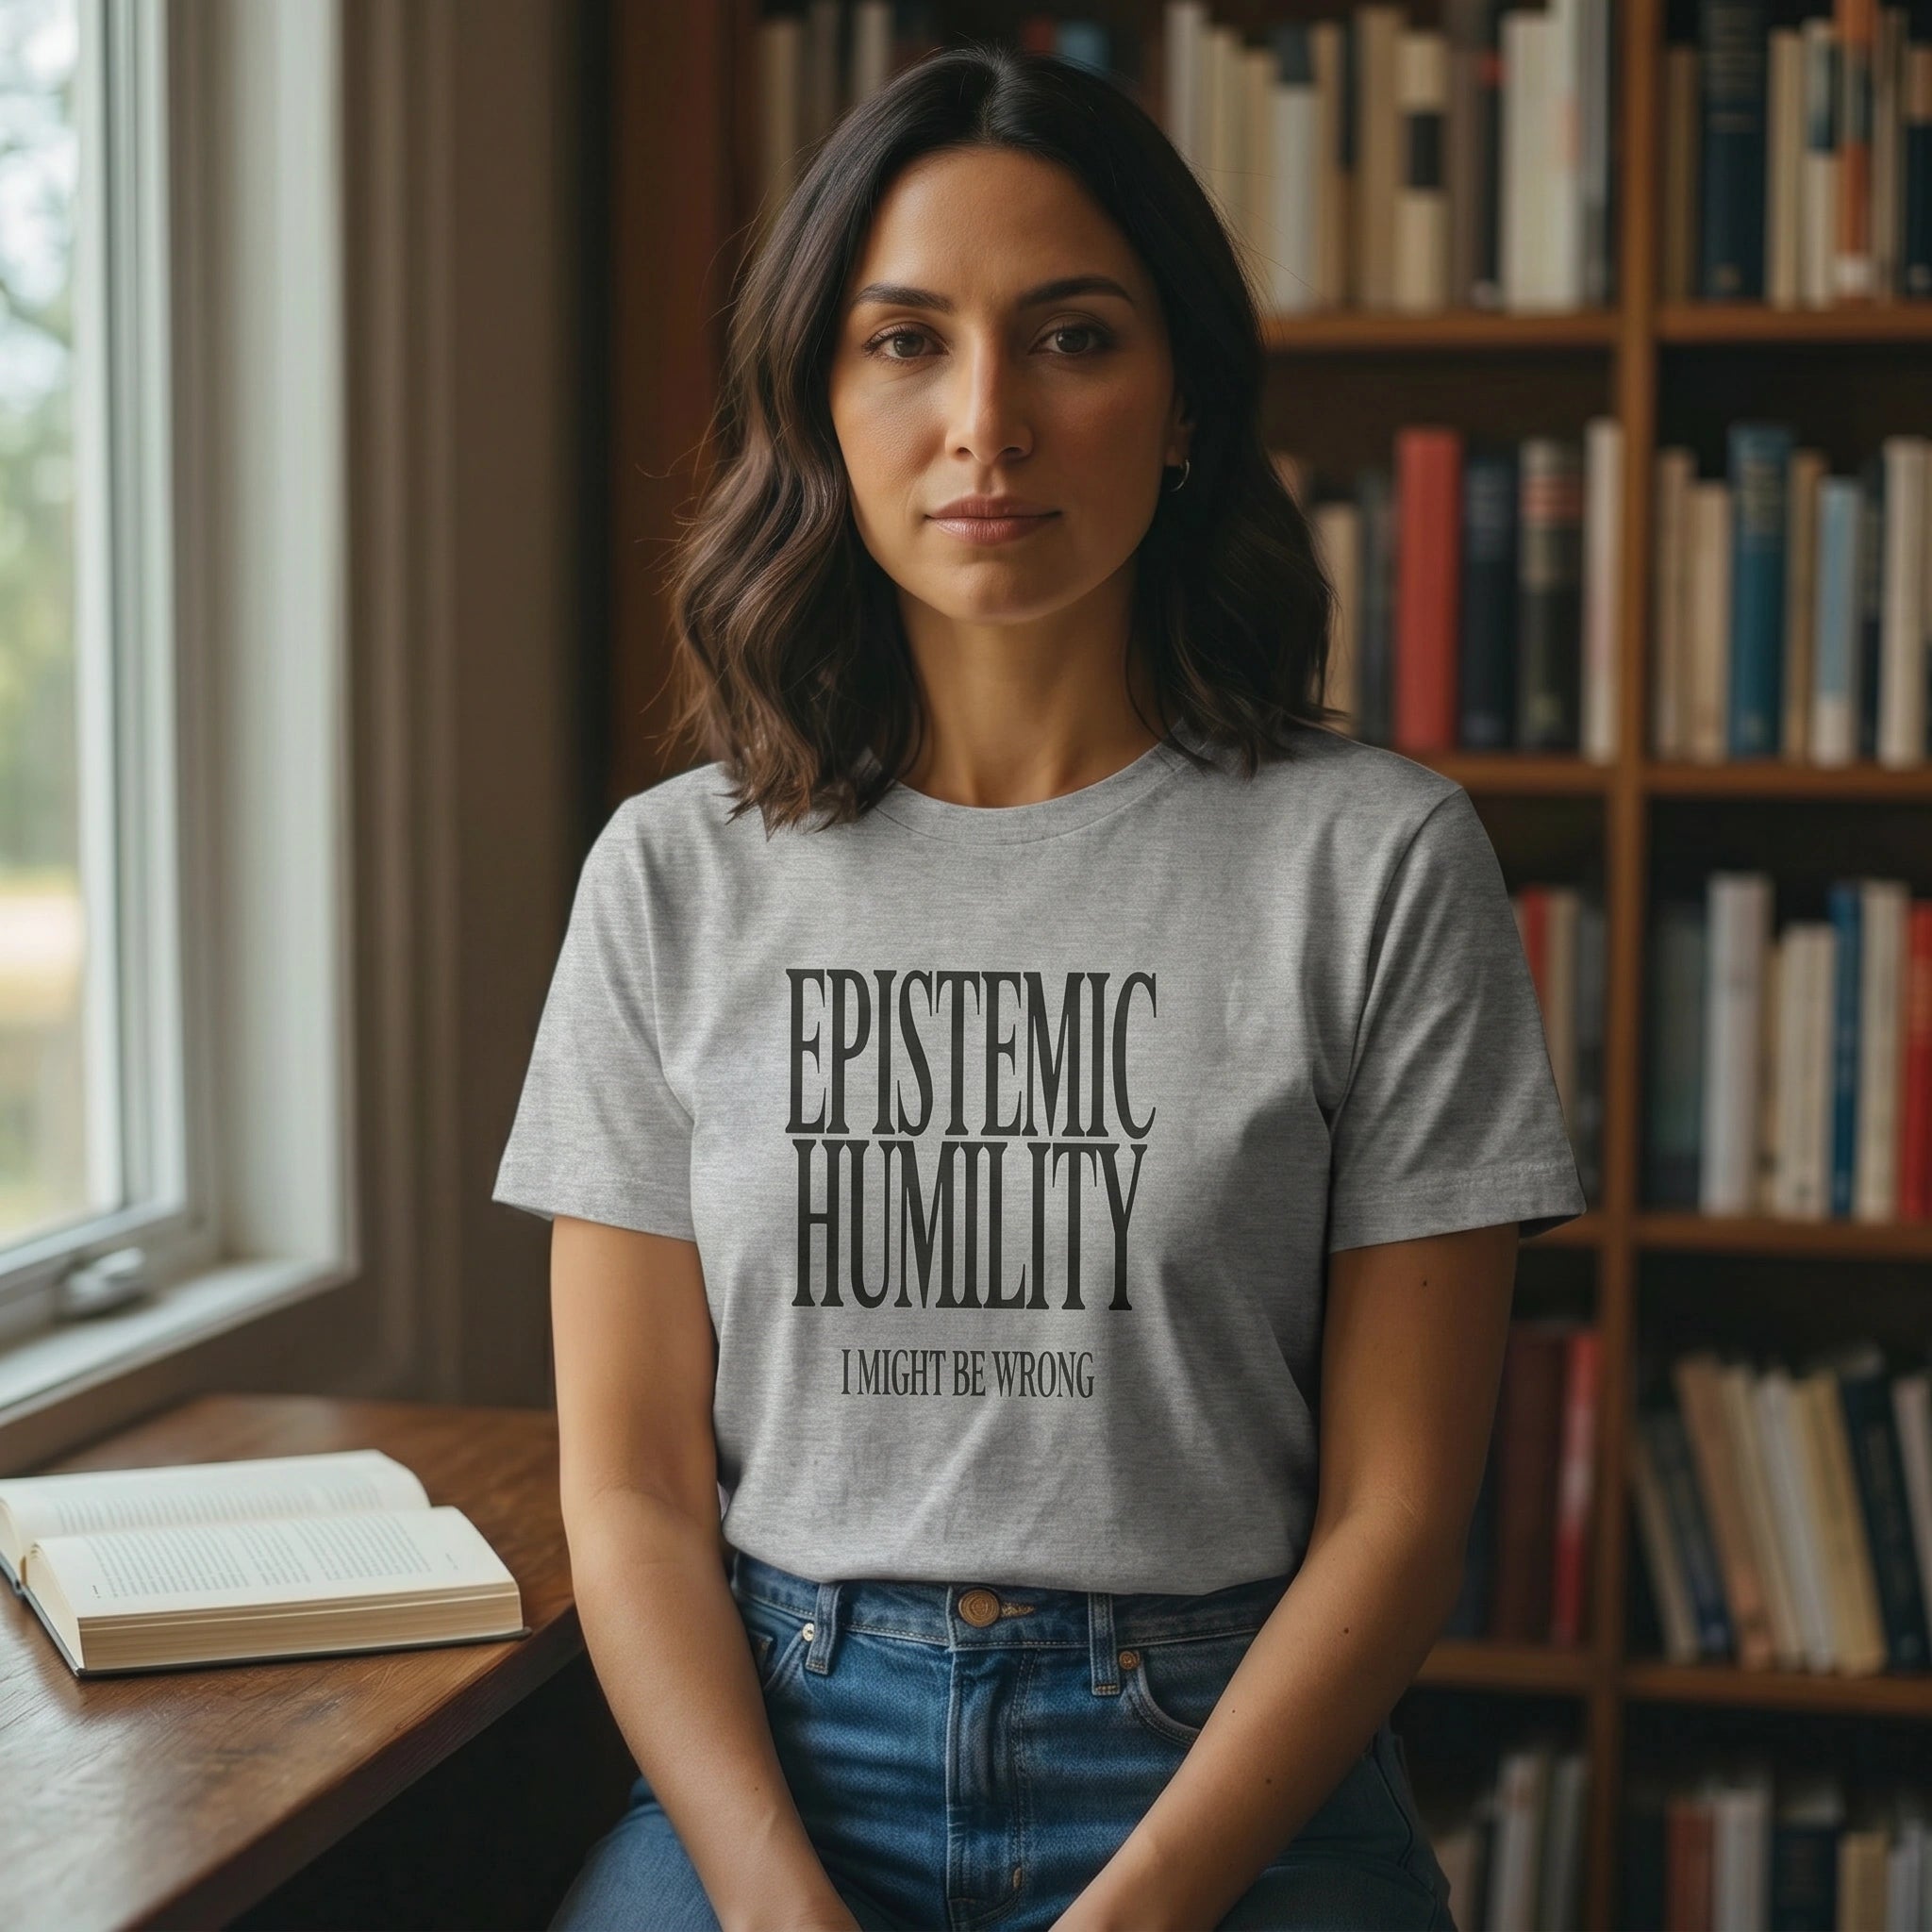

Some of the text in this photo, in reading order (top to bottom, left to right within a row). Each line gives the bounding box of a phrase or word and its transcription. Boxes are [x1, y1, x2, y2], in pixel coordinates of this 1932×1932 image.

[785, 968, 1157, 1140] EPISTEMIC
[791, 1139, 1148, 1311] HUMILITY
[841, 1348, 1095, 1399] I MIGHT BE WRONG
